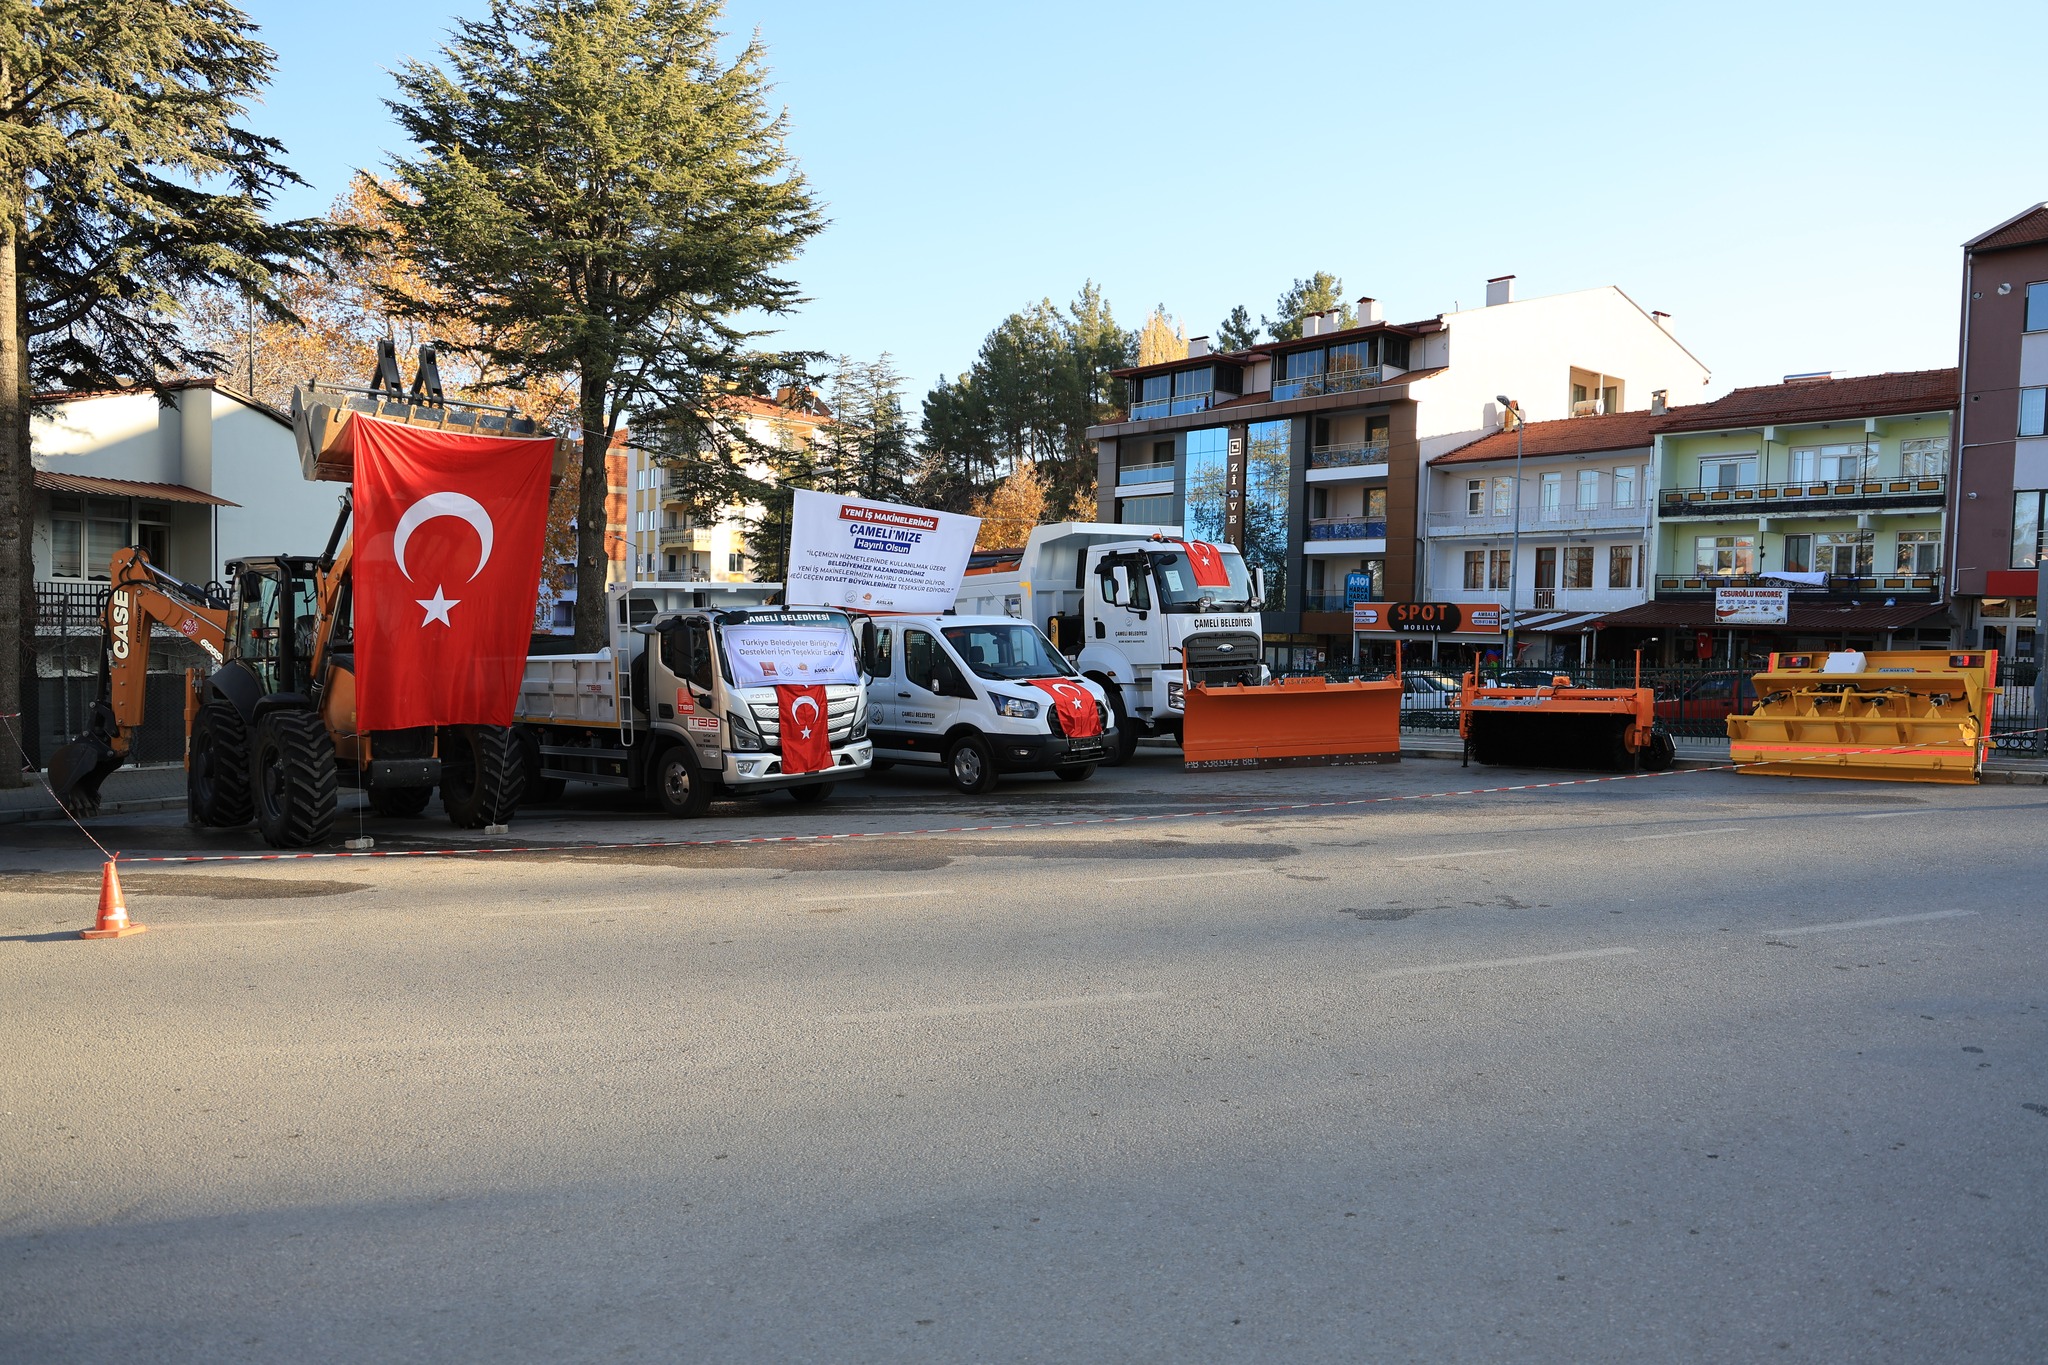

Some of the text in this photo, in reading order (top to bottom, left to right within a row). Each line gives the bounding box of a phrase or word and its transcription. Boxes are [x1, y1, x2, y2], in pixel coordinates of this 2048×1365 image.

[845, 508, 934, 528] YENİ İŞ MAKİNELERİMİZ
[857, 540, 909, 553] Hayırlı Olsun
[828, 560, 872, 571] BELEDİYEMİZE
[890, 561, 928, 570] KULLANILMAK
[803, 573, 824, 582] GEÇEN
[824, 575, 848, 583] DEVLET
[848, 577, 897, 589] BÜYÜKLERİMİZE
[1349, 576, 1369, 587] A-101
[1720, 589, 1783, 599] CESUROĞLU KOKOREÇ
[744, 612, 830, 624] AMELİ BELEDİYESİ
[1397, 604, 1448, 621] SPOT
[113, 590, 129, 659] CASE
[1194, 616, 1253, 630] ÇAMELİ BELEDİYESİ
[741, 639, 769, 648] Türkiye
[770, 639, 808, 648] Belediyeler
[739, 648, 777, 656] Destekleri
[777, 647, 791, 657] İçin
[792, 648, 822, 657] Teşekkür
[689, 717, 719, 728] TBB
